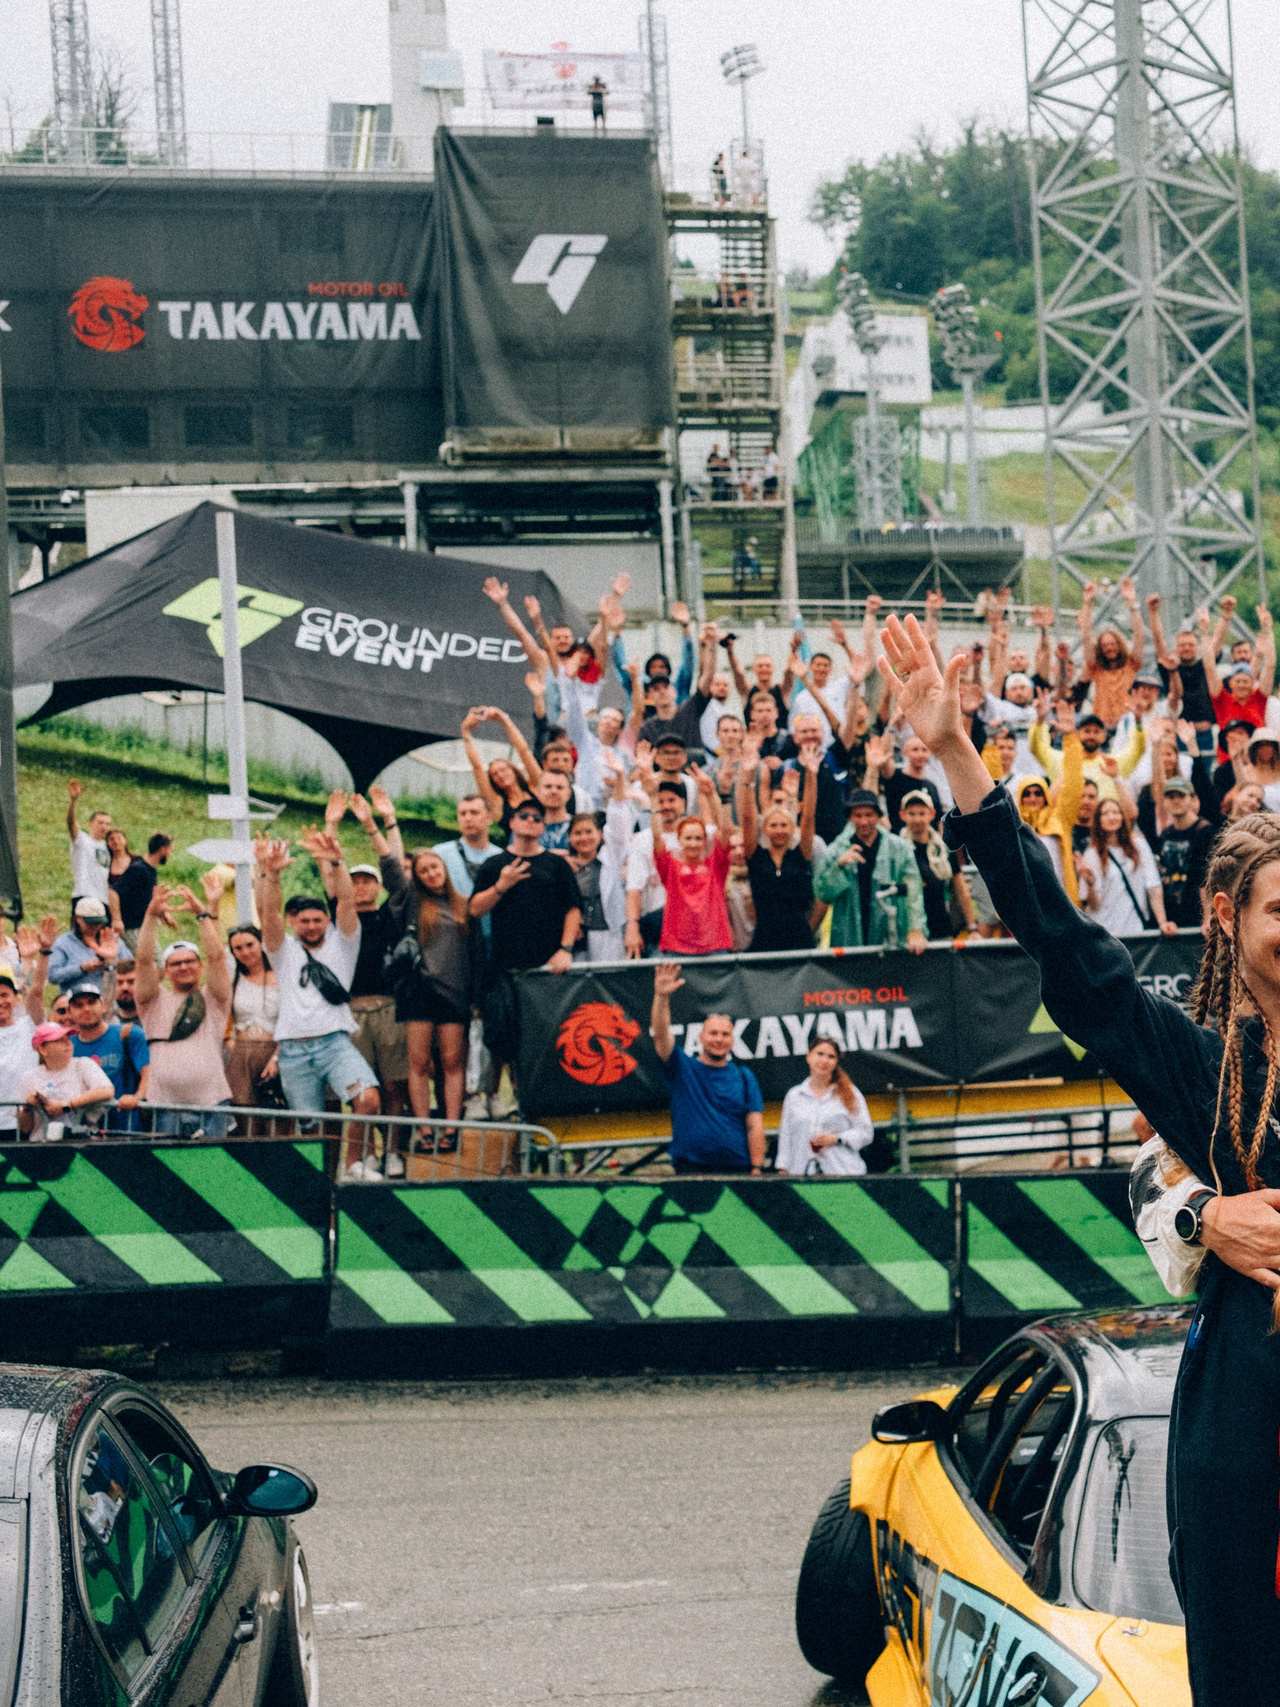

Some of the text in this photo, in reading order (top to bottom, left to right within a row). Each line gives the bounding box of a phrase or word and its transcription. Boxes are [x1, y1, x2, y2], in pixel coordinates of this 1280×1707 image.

[308, 282, 408, 297] MOTOR OIL
[158, 301, 422, 341] TAKAYAMA
[295, 624, 444, 674] EVENT
[301, 607, 529, 663] GROUNDED
[803, 986, 909, 1007] MOTOR OIL
